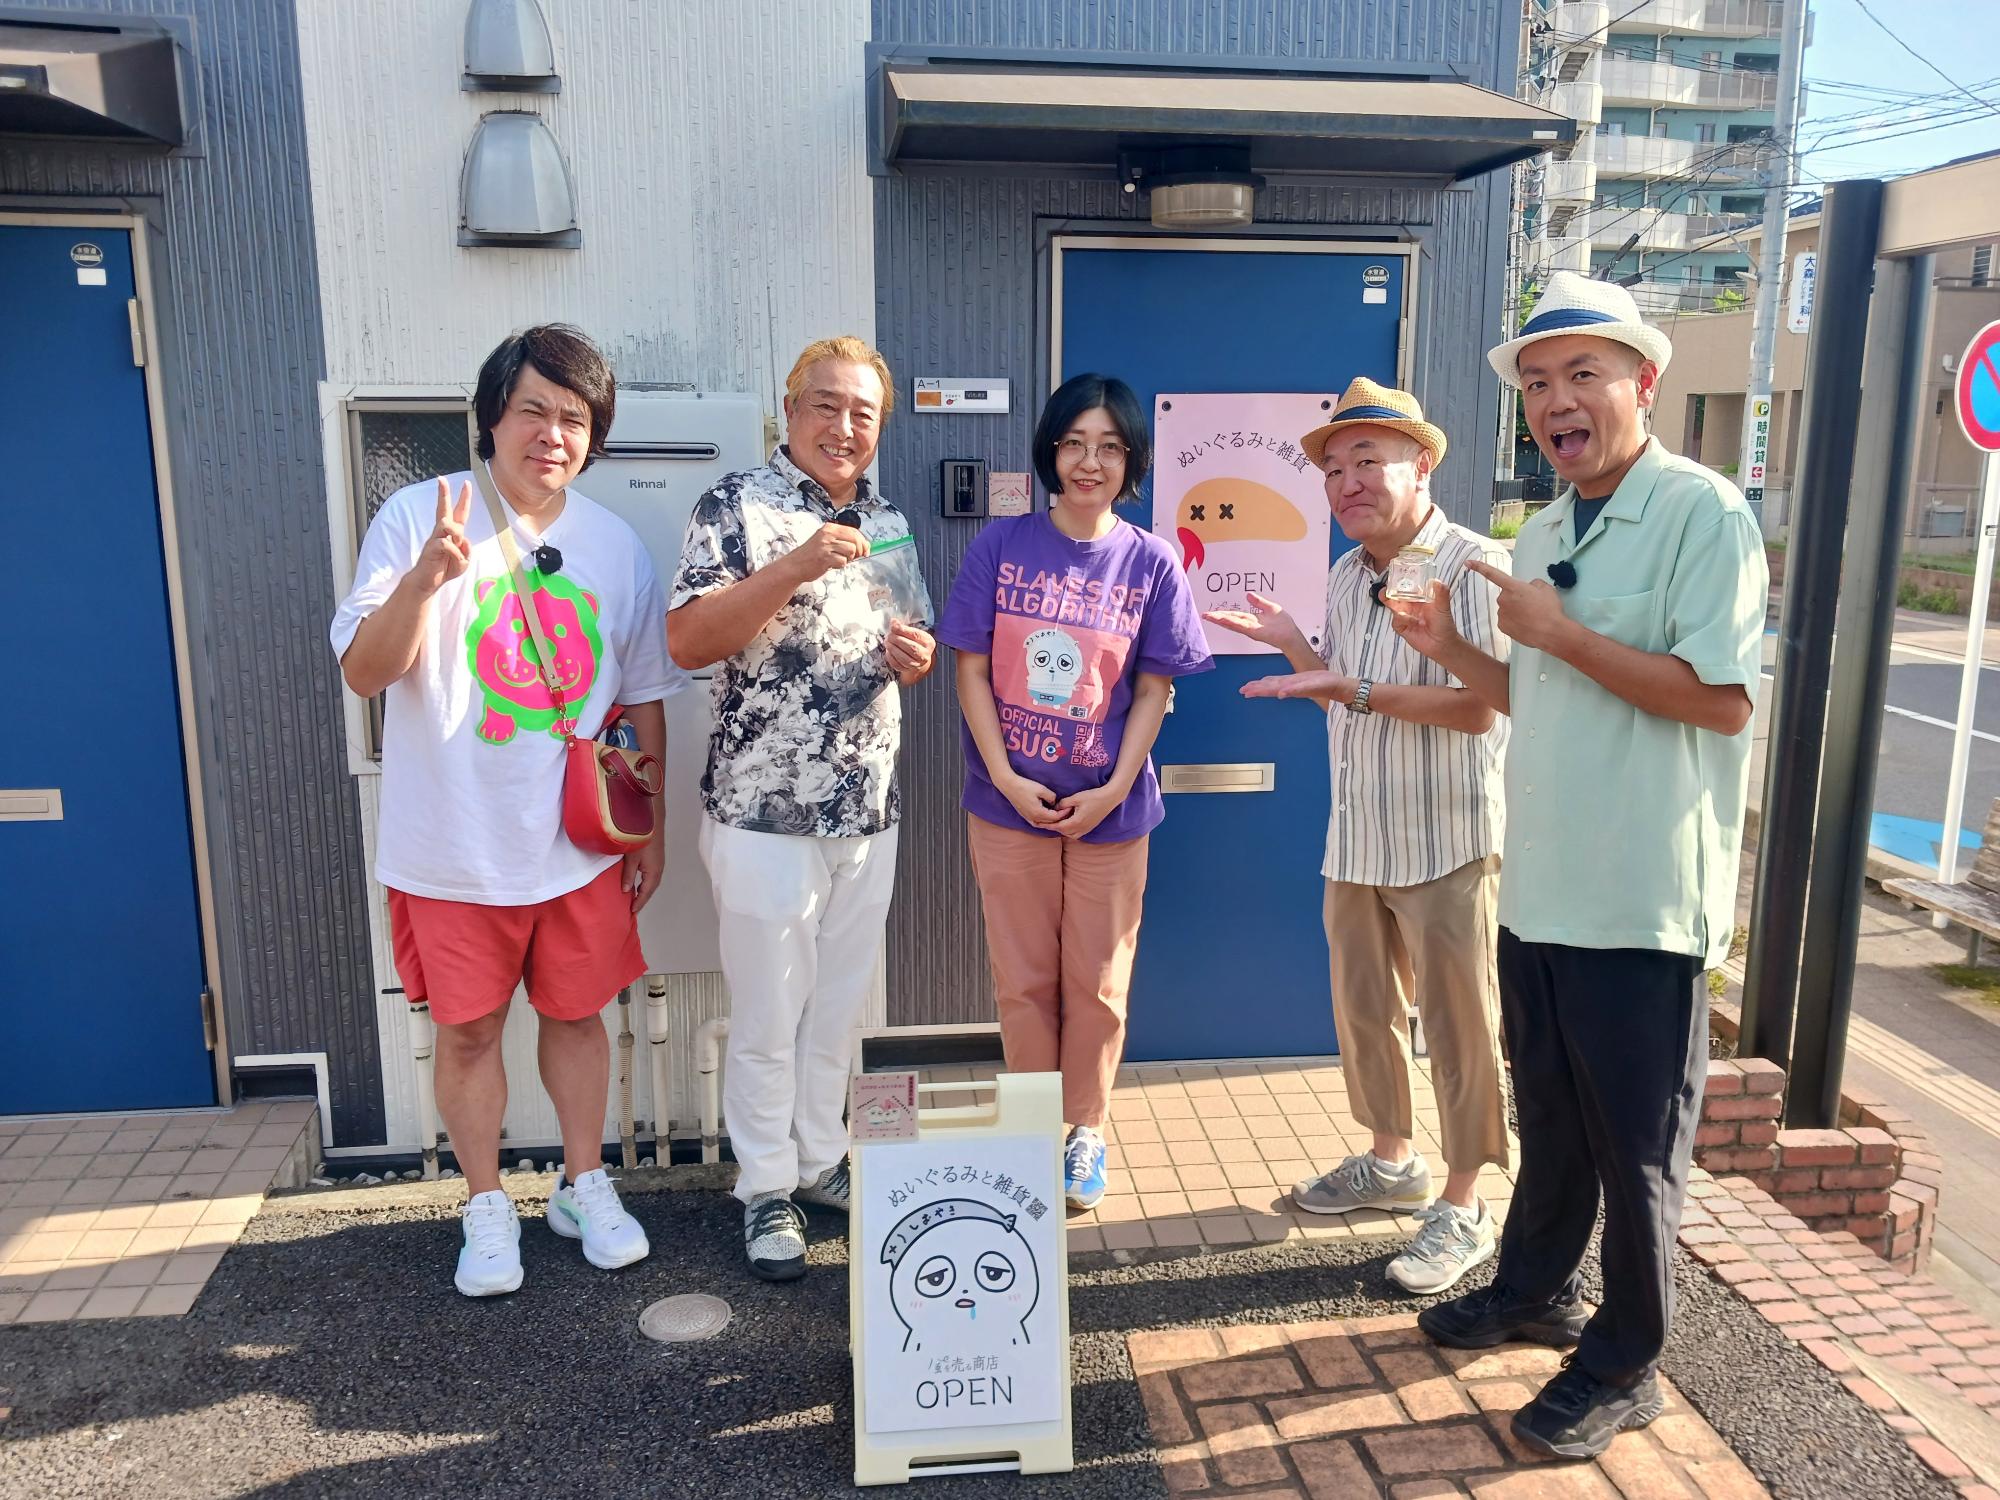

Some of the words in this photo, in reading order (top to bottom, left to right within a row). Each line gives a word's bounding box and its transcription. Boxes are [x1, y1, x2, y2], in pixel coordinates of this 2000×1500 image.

[917, 379, 940, 389] A-1
[1177, 431, 1311, 474] ぬいぐるみと雑貨
[1755, 421, 1768, 463] 時間貸
[629, 479, 667, 489] Rinnai
[997, 561, 1104, 604] SLAVES
[1110, 584, 1146, 610] OF
[1206, 572, 1275, 592] OPEN
[996, 587, 1141, 635] ALGORITHM
[887, 1165, 1032, 1208] ぬいぐるみと雑貨
[916, 1375, 1012, 1409] OPEN
